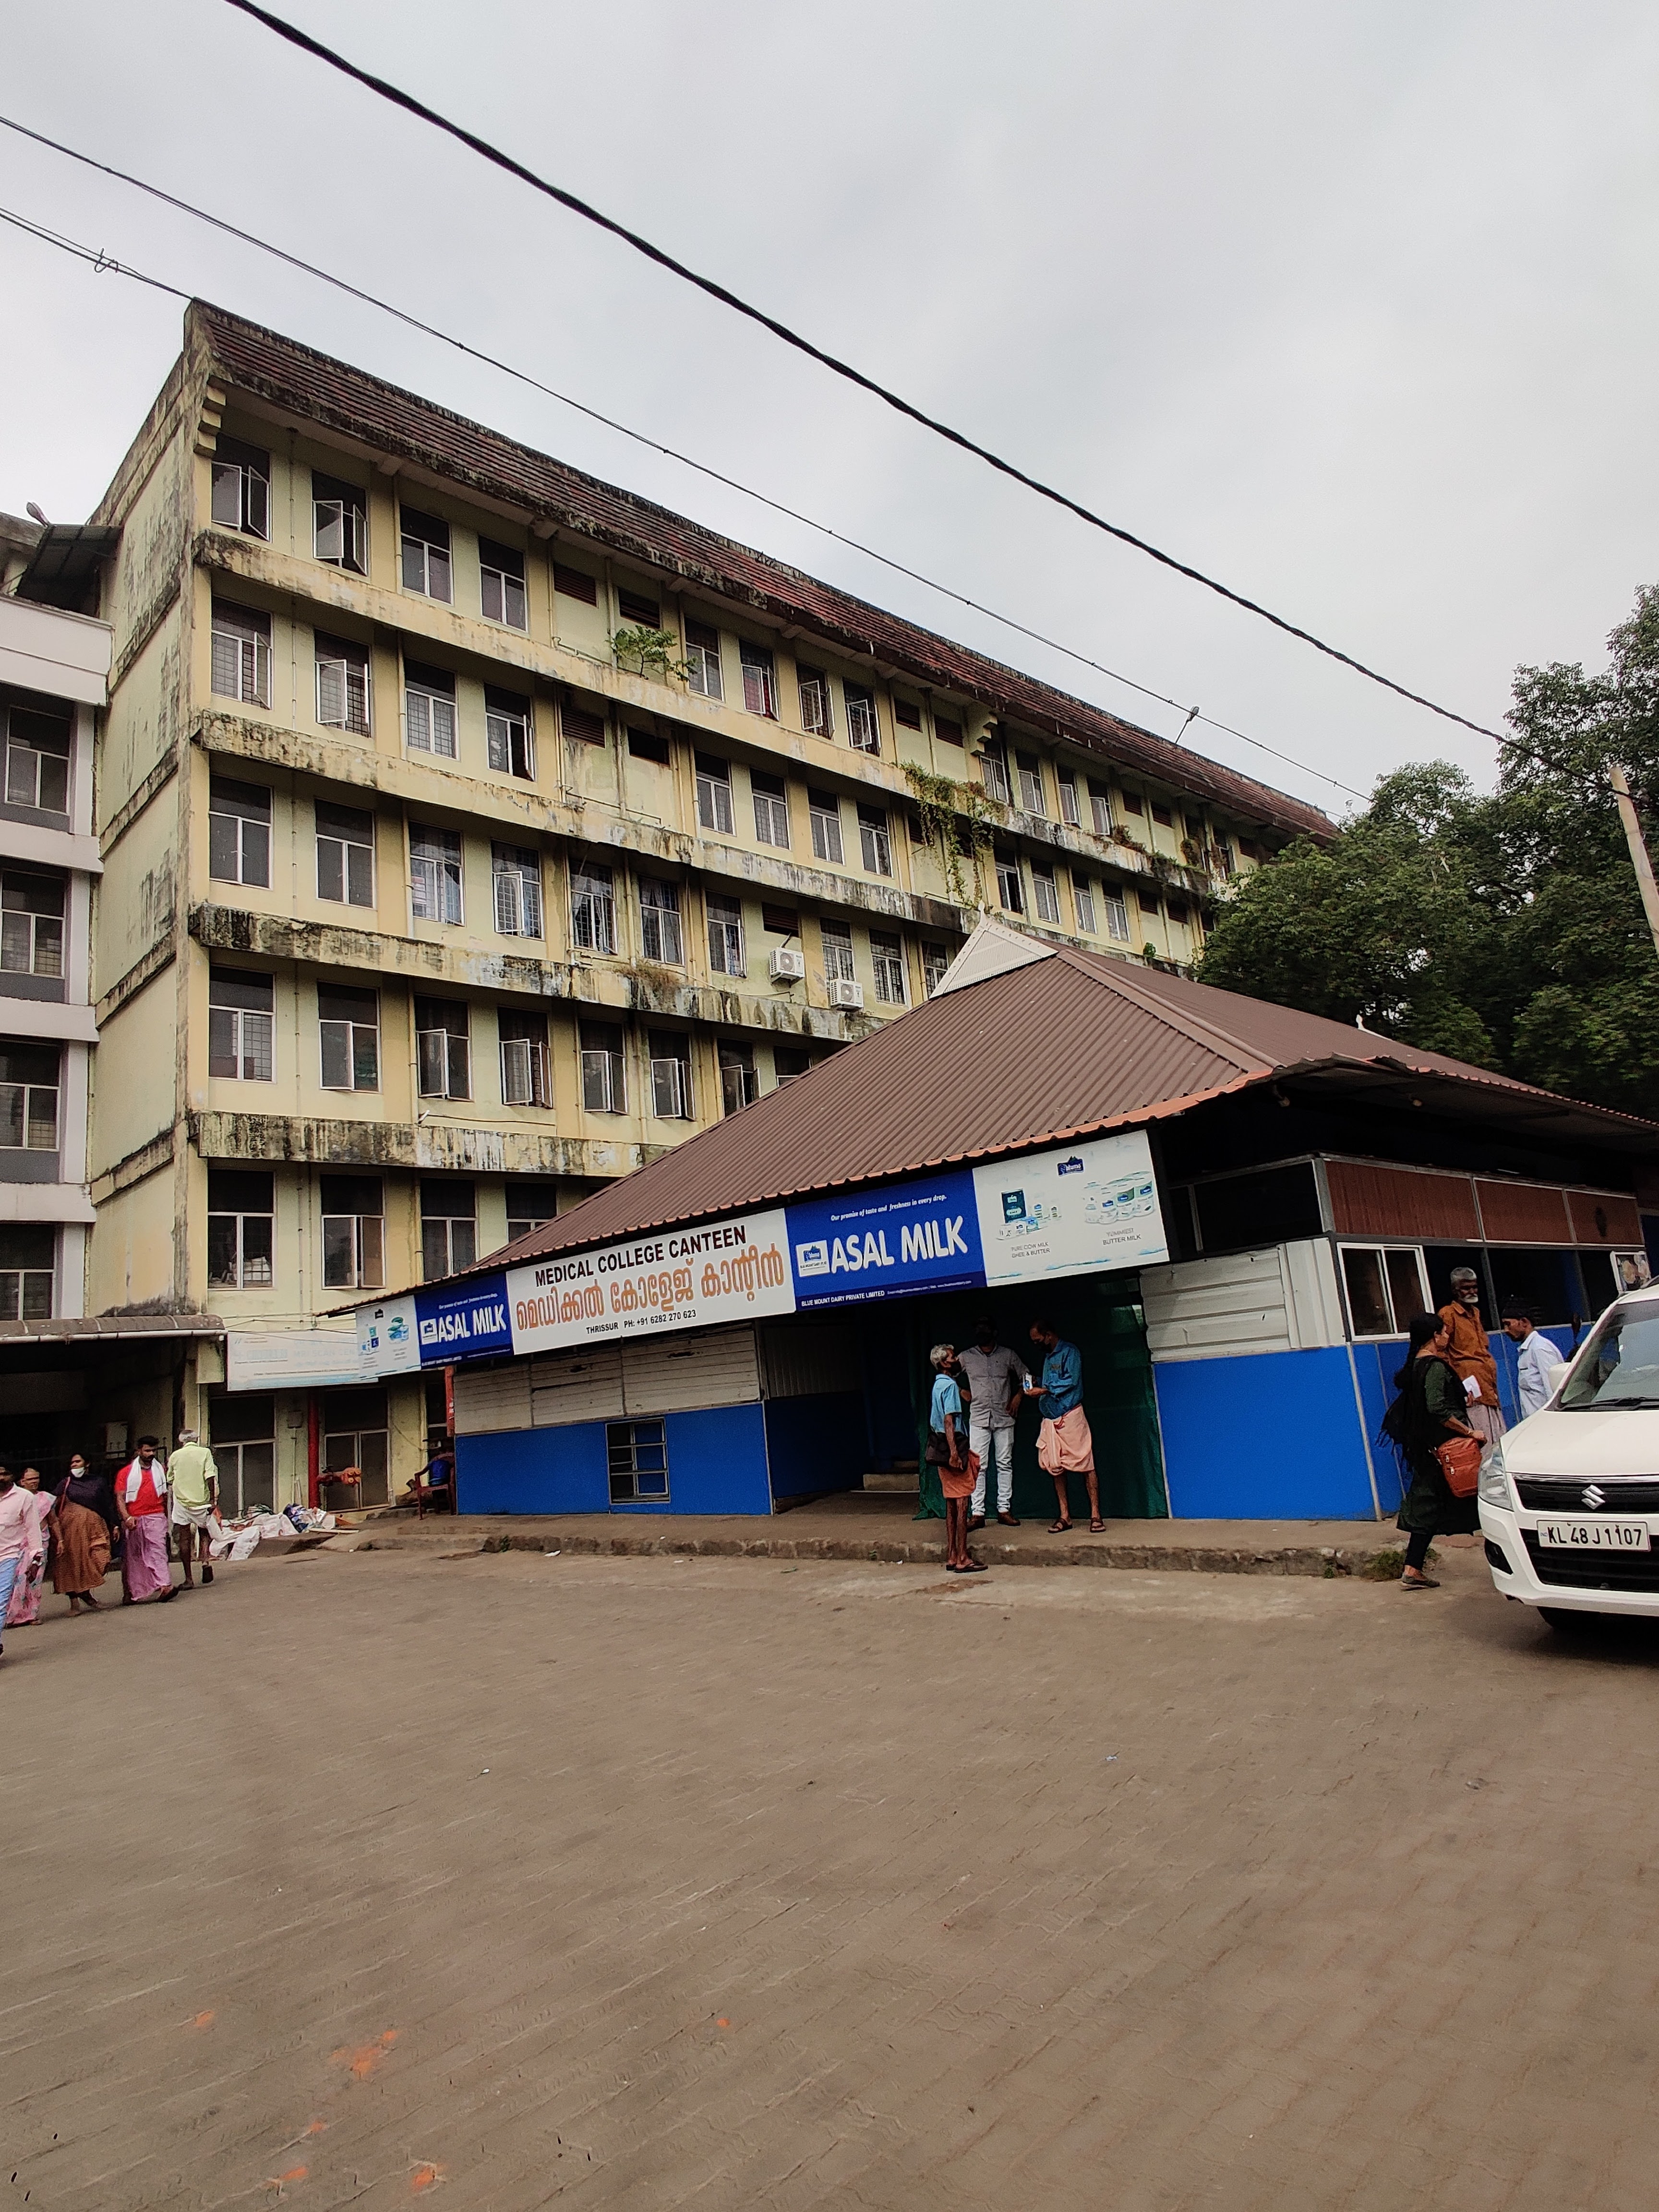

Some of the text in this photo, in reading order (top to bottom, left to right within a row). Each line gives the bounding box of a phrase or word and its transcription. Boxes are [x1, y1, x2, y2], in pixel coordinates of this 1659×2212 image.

[841, 1211, 858, 1221] promise
[889, 1203, 911, 1212] freshness
[831, 1215, 968, 1274] ASAL MILK
[1103, 1237, 1126, 1245] BUTTER
[535, 1225, 746, 1287] MEDICAL COLLEGE CANTEEN
[610, 1258, 694, 1313] കോളേജ്
[845, 1293, 865, 1301] PRIVATE
[866, 1290, 885, 1298] LIMITED
[438, 1304, 506, 1343] ASAL MILK
[586, 1310, 696, 1334] THRISSUR PH: +91 6282 270 623
[1547, 1527, 1567, 1543] KL
[1571, 1527, 1588, 1544] 48
[1604, 1528, 1642, 1546] 1107
